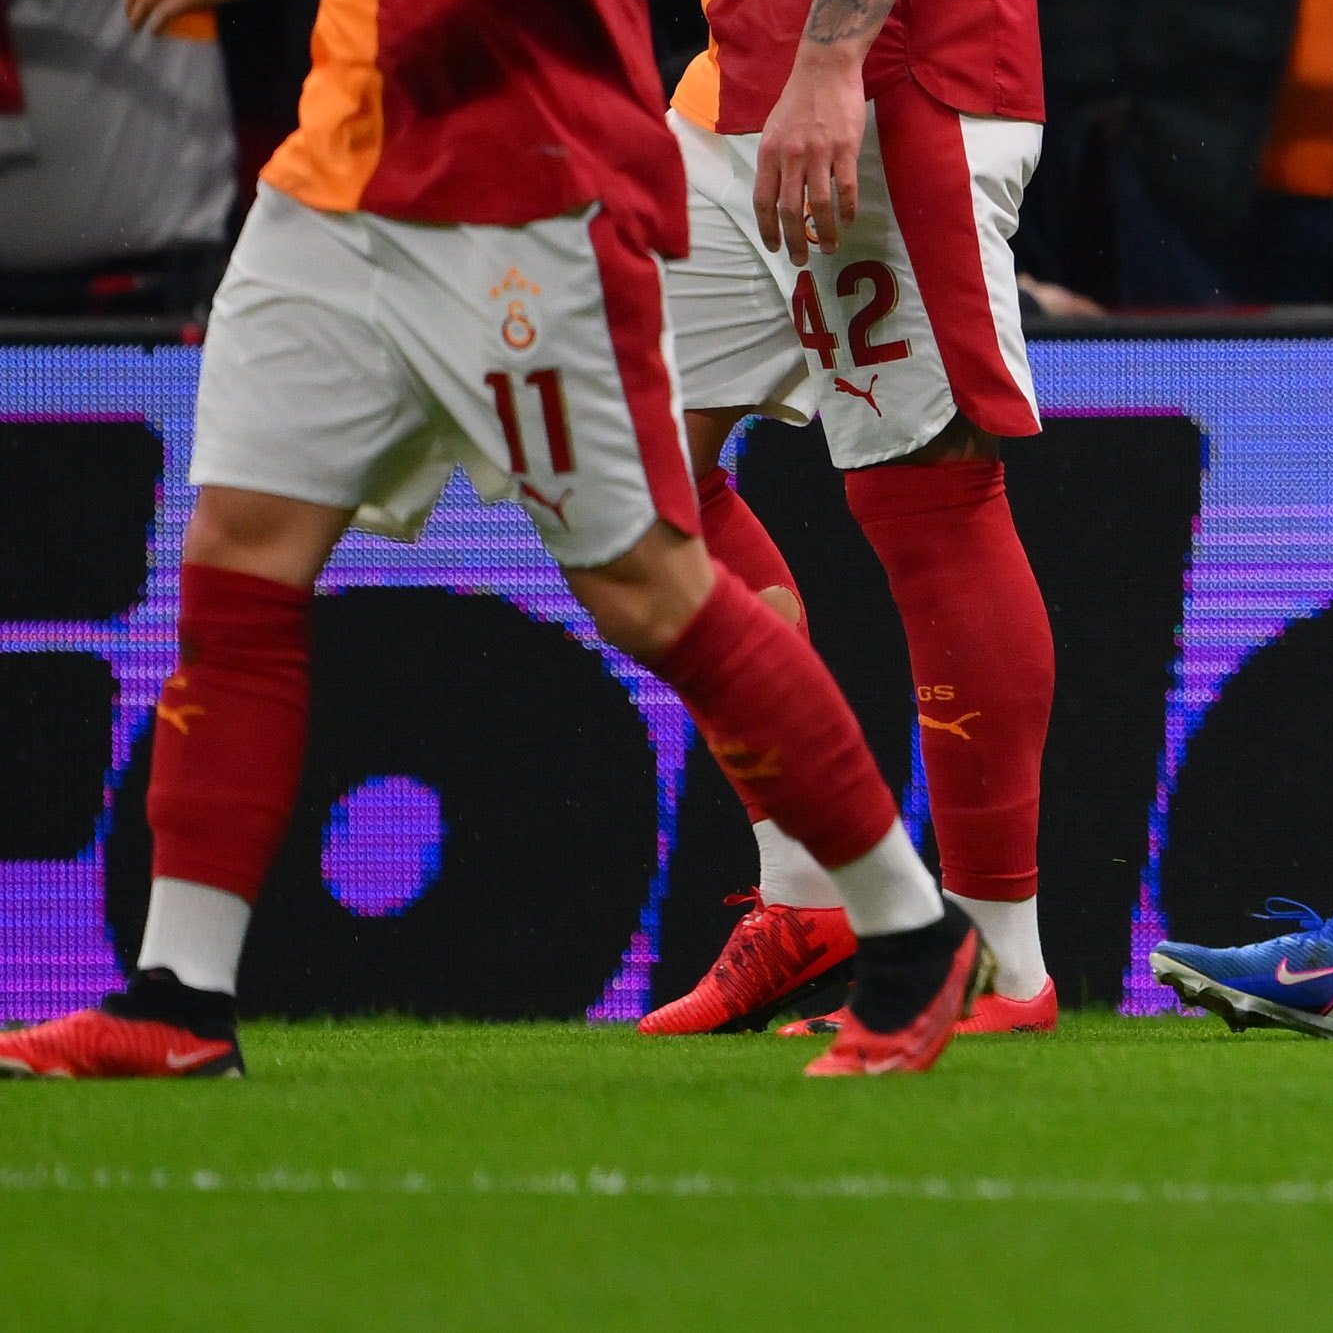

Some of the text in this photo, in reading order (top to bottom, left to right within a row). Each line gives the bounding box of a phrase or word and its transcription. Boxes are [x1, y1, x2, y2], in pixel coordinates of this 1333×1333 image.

[793, 260, 914, 370] 42
[485, 368, 578, 475] 11
[917, 684, 955, 702] GS
